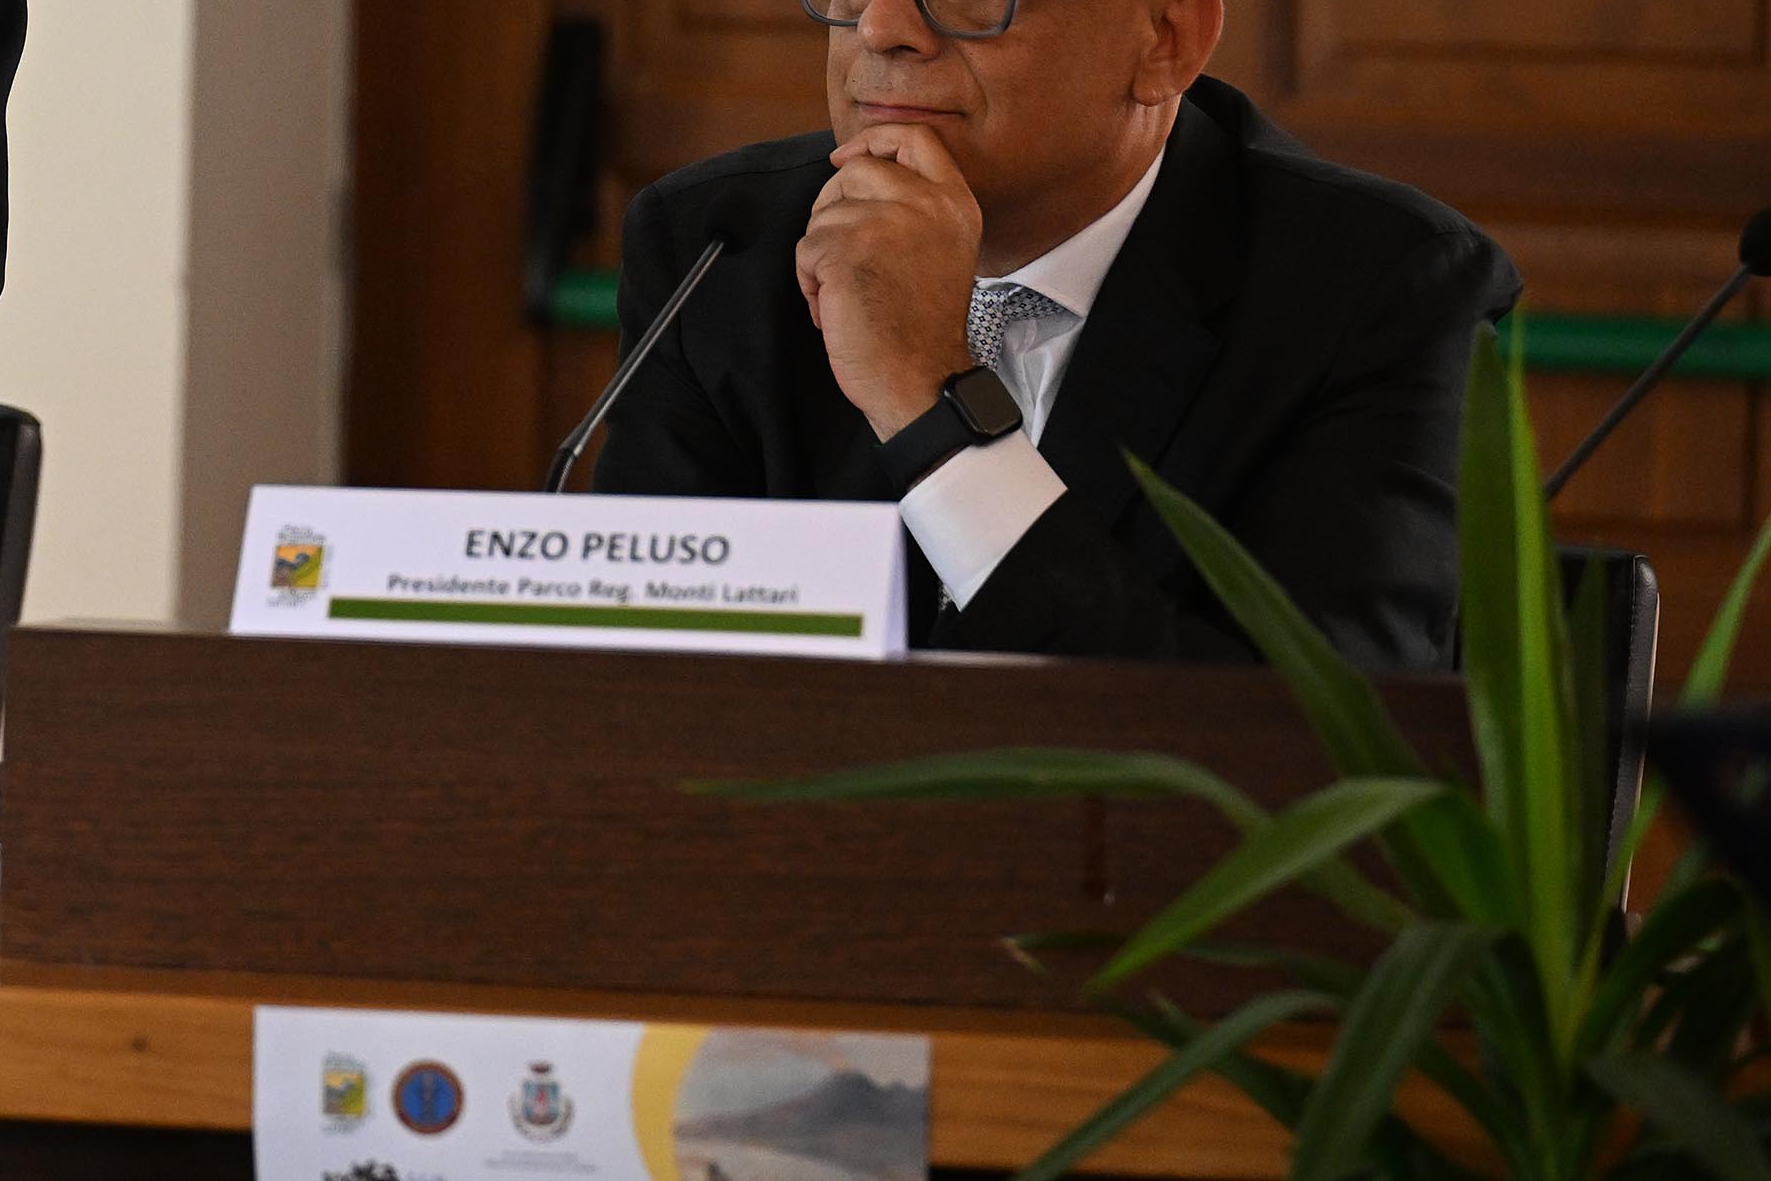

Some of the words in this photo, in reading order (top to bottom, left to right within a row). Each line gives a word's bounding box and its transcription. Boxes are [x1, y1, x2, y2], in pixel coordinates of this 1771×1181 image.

[465, 529, 569, 561] ENZO
[582, 532, 731, 565] PELUSO
[387, 574, 510, 595] Presidente
[517, 577, 581, 597] Parco
[644, 581, 716, 601] Monti
[722, 583, 800, 604] Lattari
